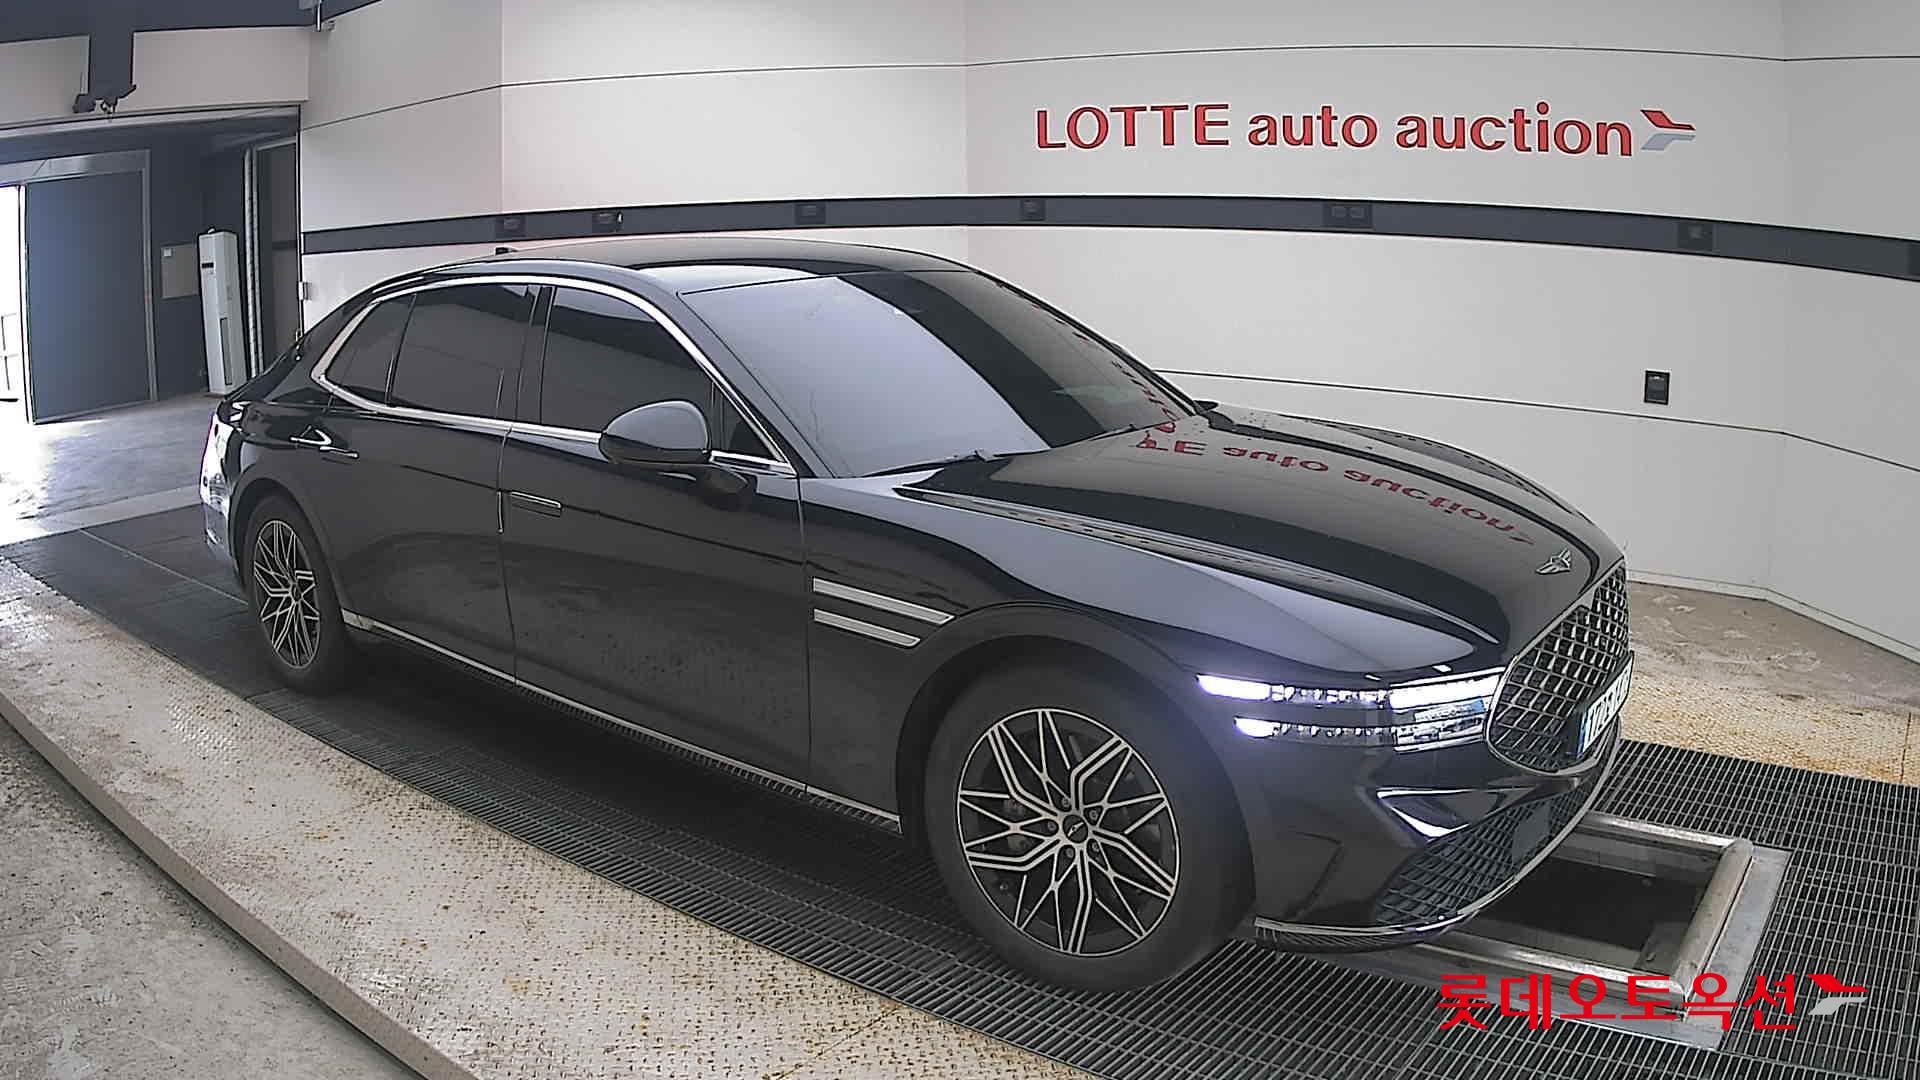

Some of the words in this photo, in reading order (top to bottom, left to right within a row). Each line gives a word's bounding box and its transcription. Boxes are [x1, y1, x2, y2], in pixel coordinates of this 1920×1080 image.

[1036, 103, 1230, 149] LOTTE
[1247, 105, 1378, 149] auto
[1396, 101, 1633, 157] auction
